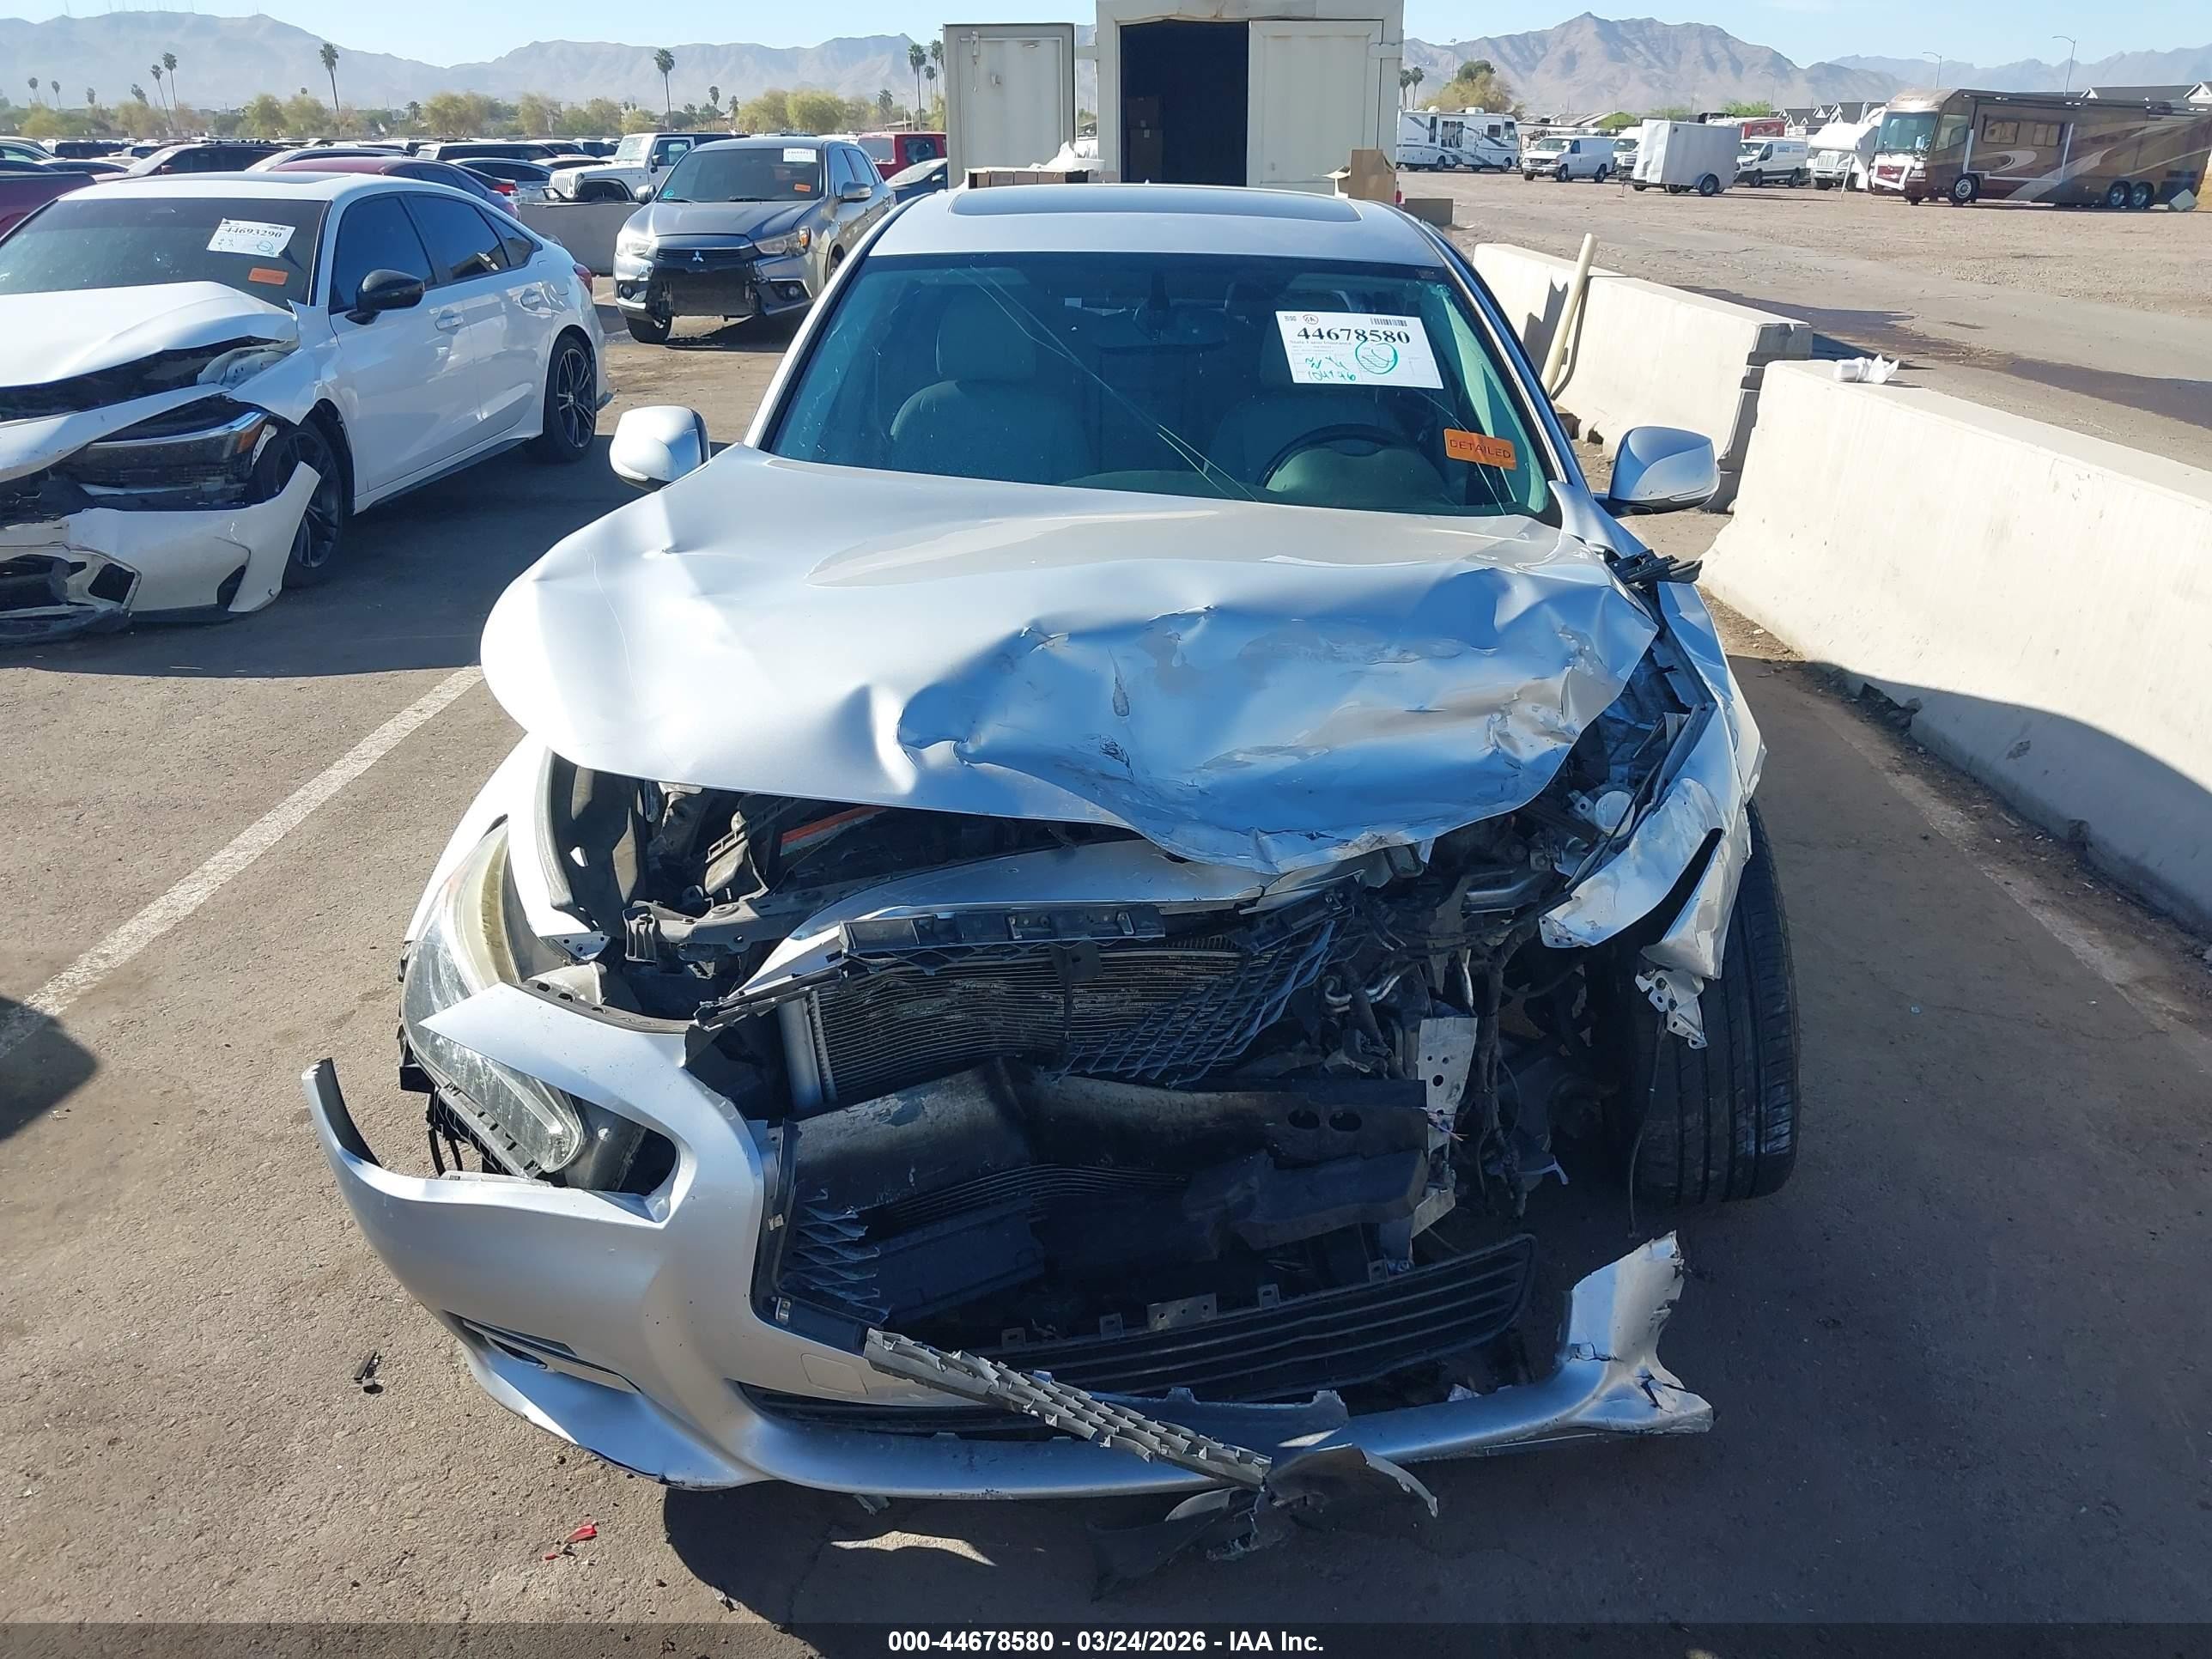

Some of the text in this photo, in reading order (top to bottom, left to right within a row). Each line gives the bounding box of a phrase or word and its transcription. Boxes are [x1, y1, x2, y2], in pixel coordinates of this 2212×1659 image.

[225, 226, 283, 239] 44693290
[1297, 326, 1410, 344] 44678580
[1449, 439, 1511, 459] DETAILED
